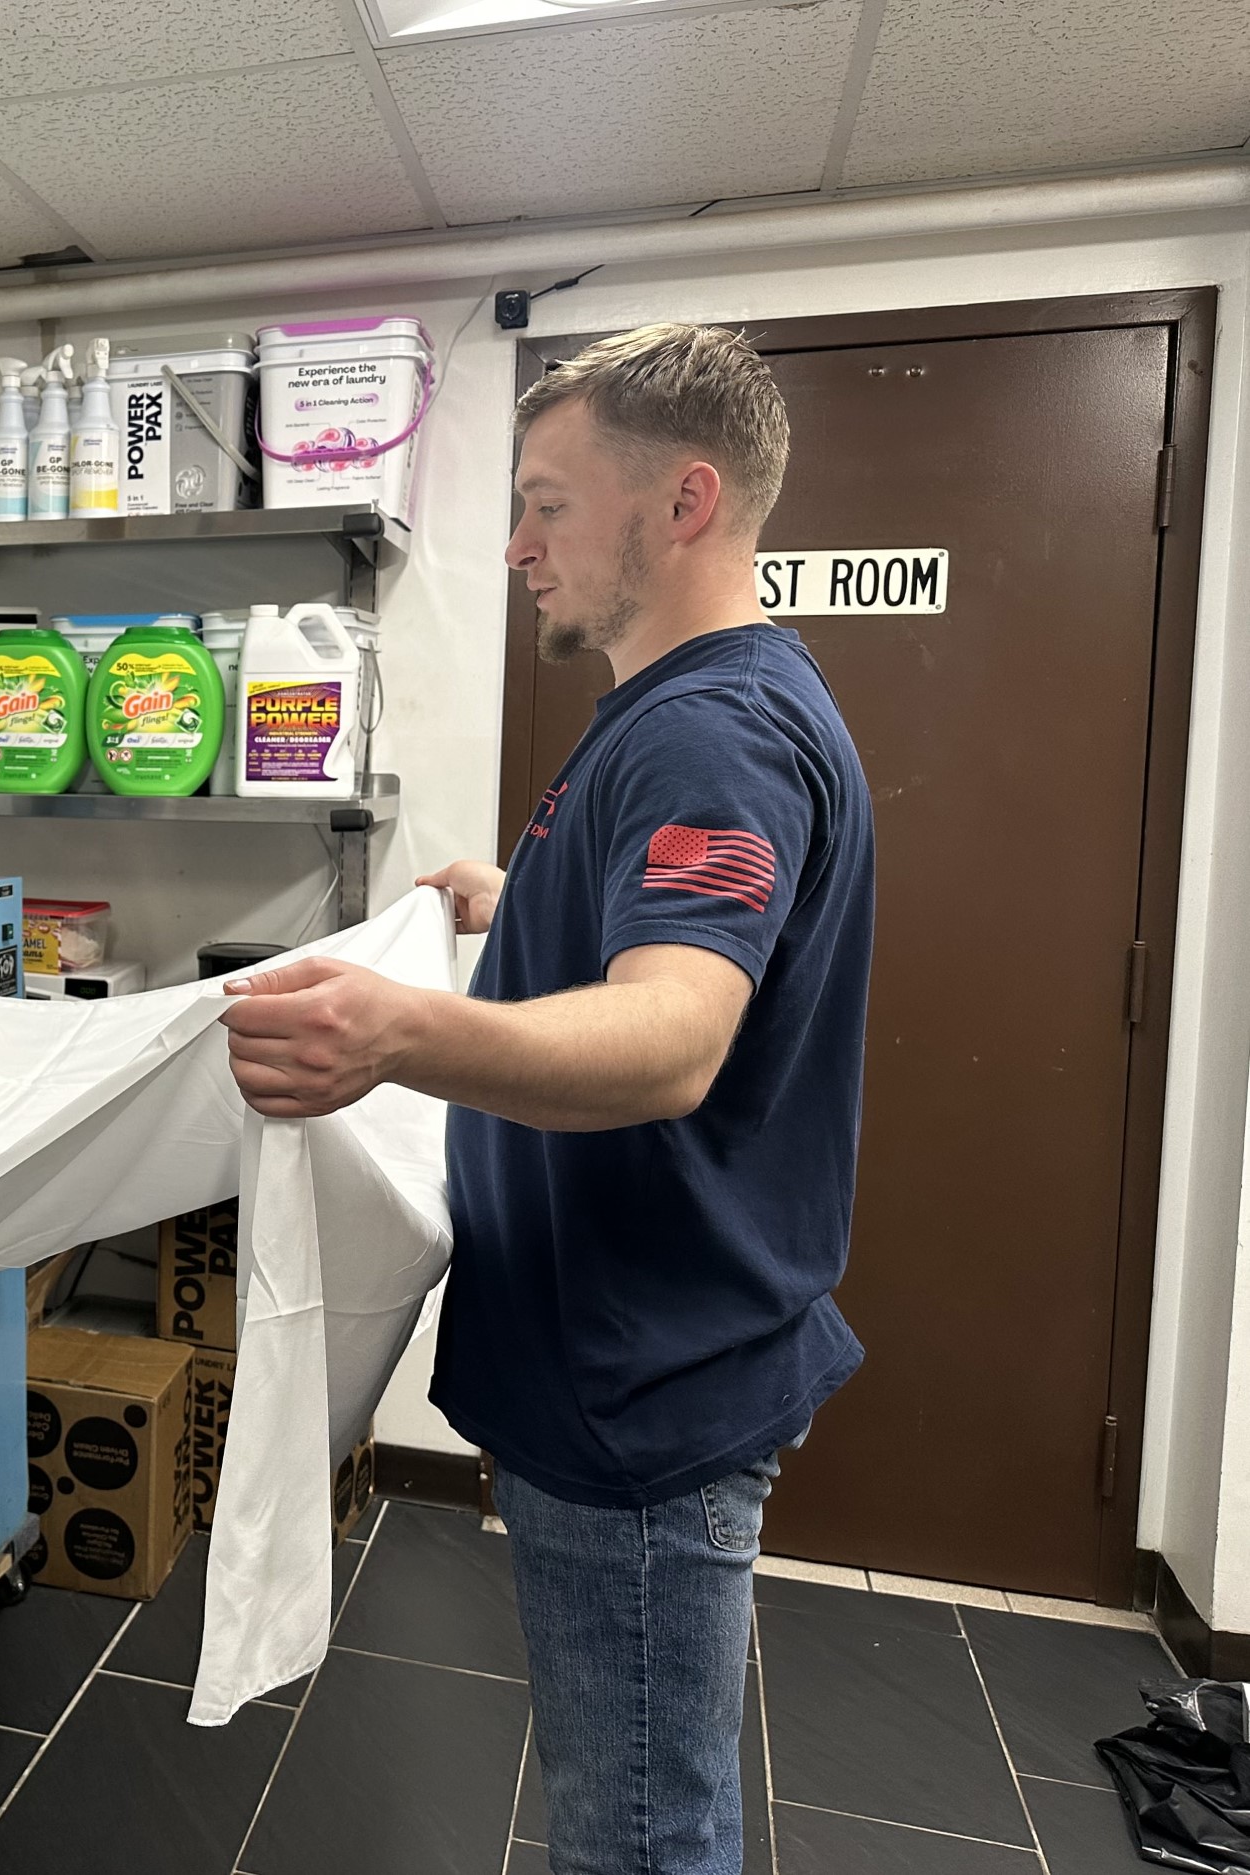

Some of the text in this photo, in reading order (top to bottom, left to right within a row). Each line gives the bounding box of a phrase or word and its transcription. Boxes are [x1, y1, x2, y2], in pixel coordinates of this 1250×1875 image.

[298, 363, 377, 378] Experience the
[288, 380, 310, 388] new
[332, 376, 344, 385] of
[346, 373, 386, 385] laundry
[318, 397, 349, 407] Cleaning
[350, 395, 374, 404] Action
[145, 391, 163, 441] PAX
[127, 391, 144, 480] POWER
[1, 459, 14, 467] GP
[49, 456, 62, 464] GP
[36, 465, 70, 474] BE-GON
[754, 557, 938, 608] ST ROOM
[123, 692, 173, 718] Gain
[251, 697, 338, 712] PURPLE
[141, 713, 169, 727] flings!
[251, 713, 338, 727] POWER
[23, 938, 47, 949] AMEL
[173, 1205, 207, 1340] POWE
